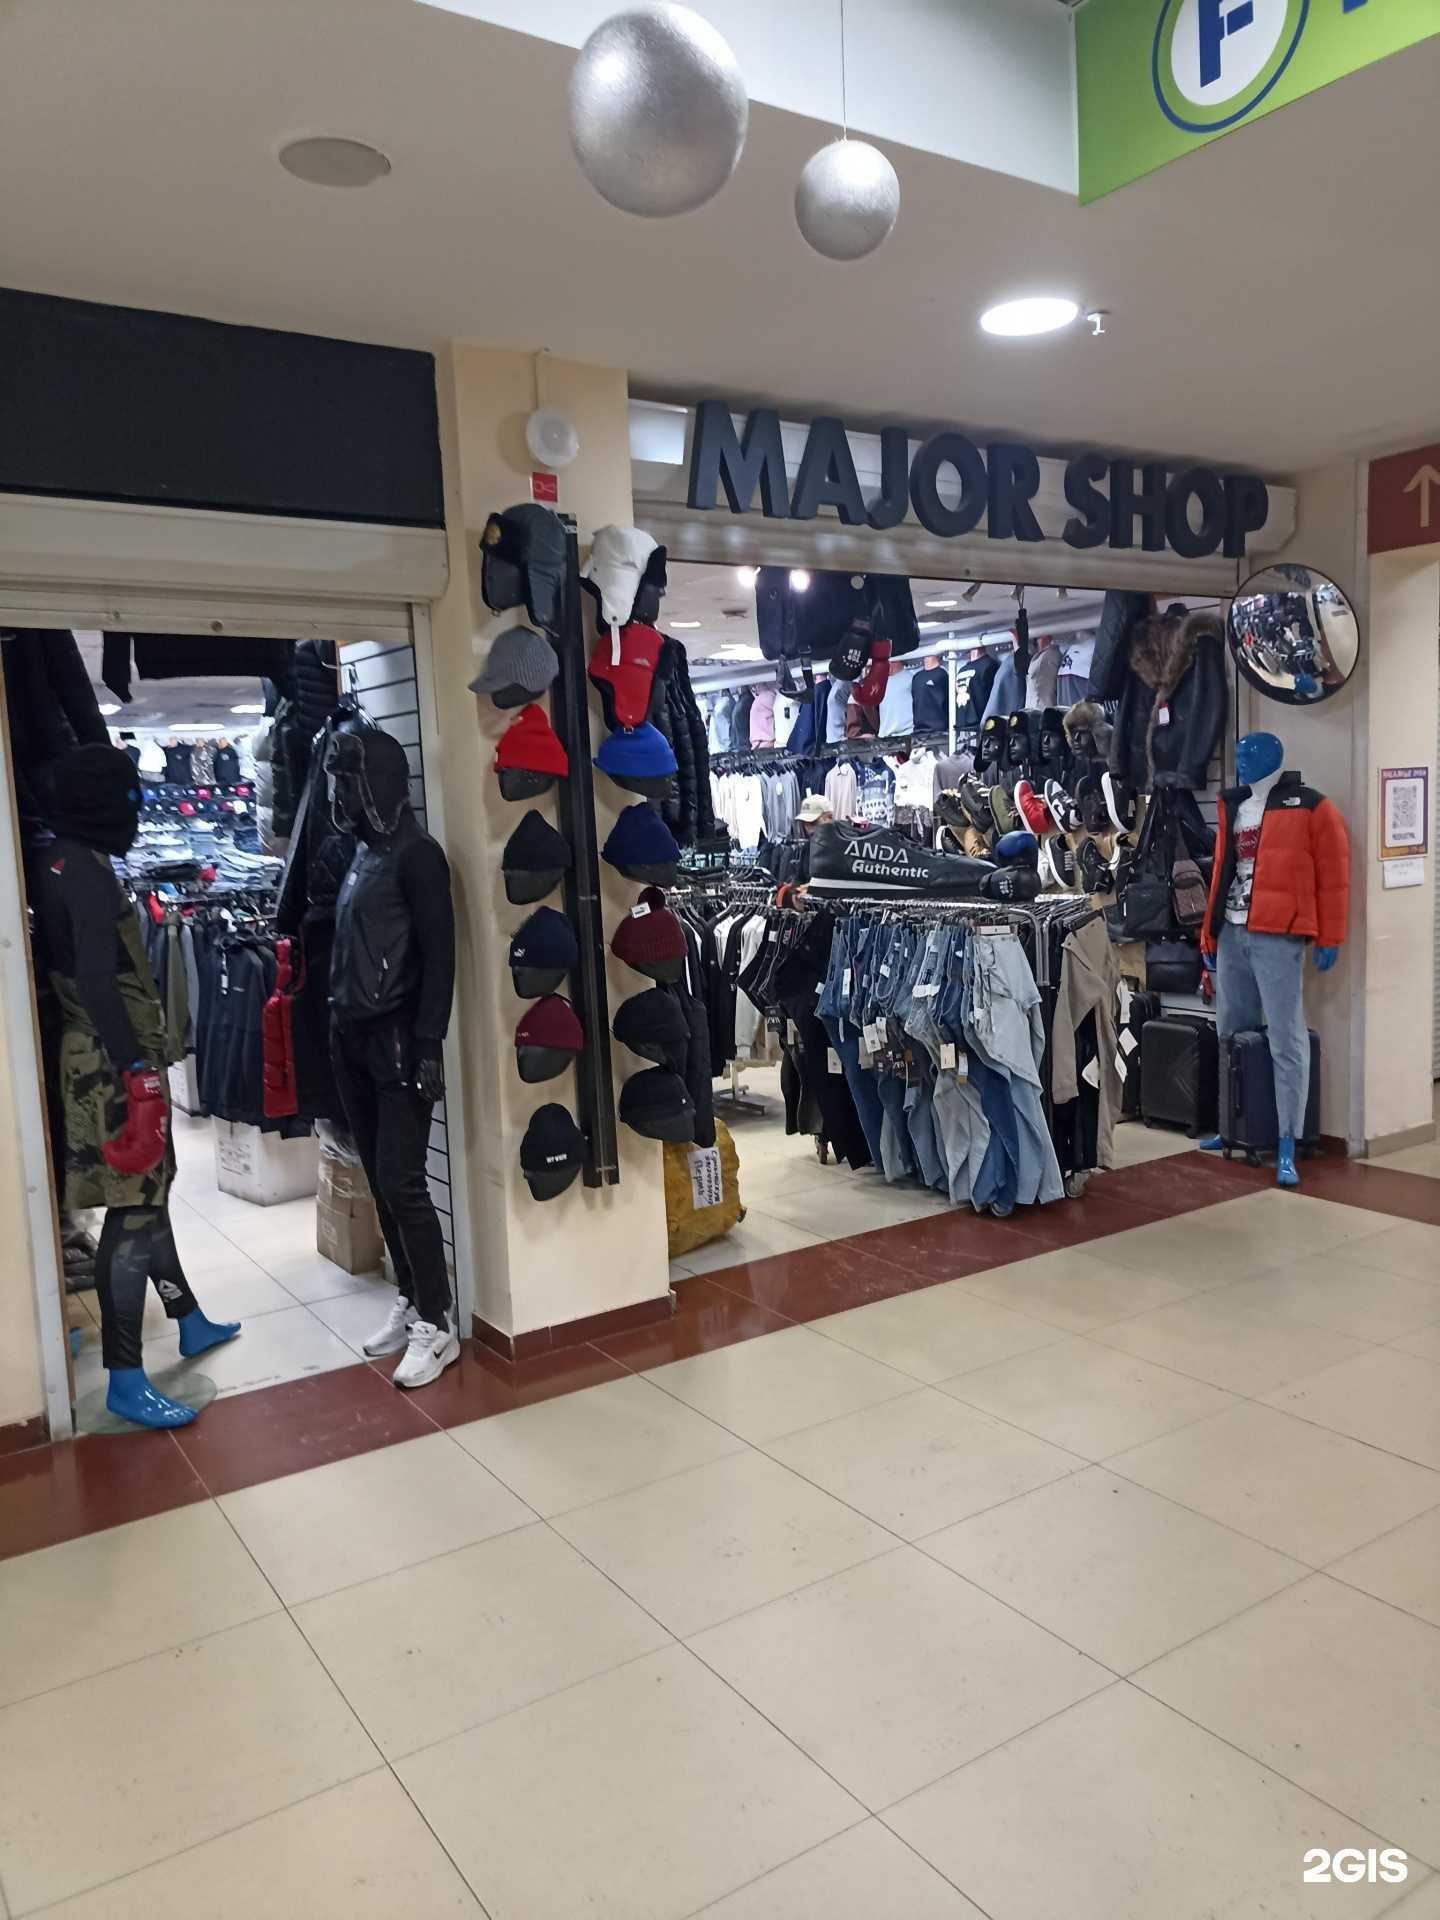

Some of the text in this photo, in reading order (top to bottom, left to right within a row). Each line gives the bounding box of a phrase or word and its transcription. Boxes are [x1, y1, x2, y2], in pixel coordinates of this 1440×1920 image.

[687, 401, 1269, 558] MAJOR SHOP
[844, 840, 909, 864] ANDA
[852, 859, 929, 878] Authentic
